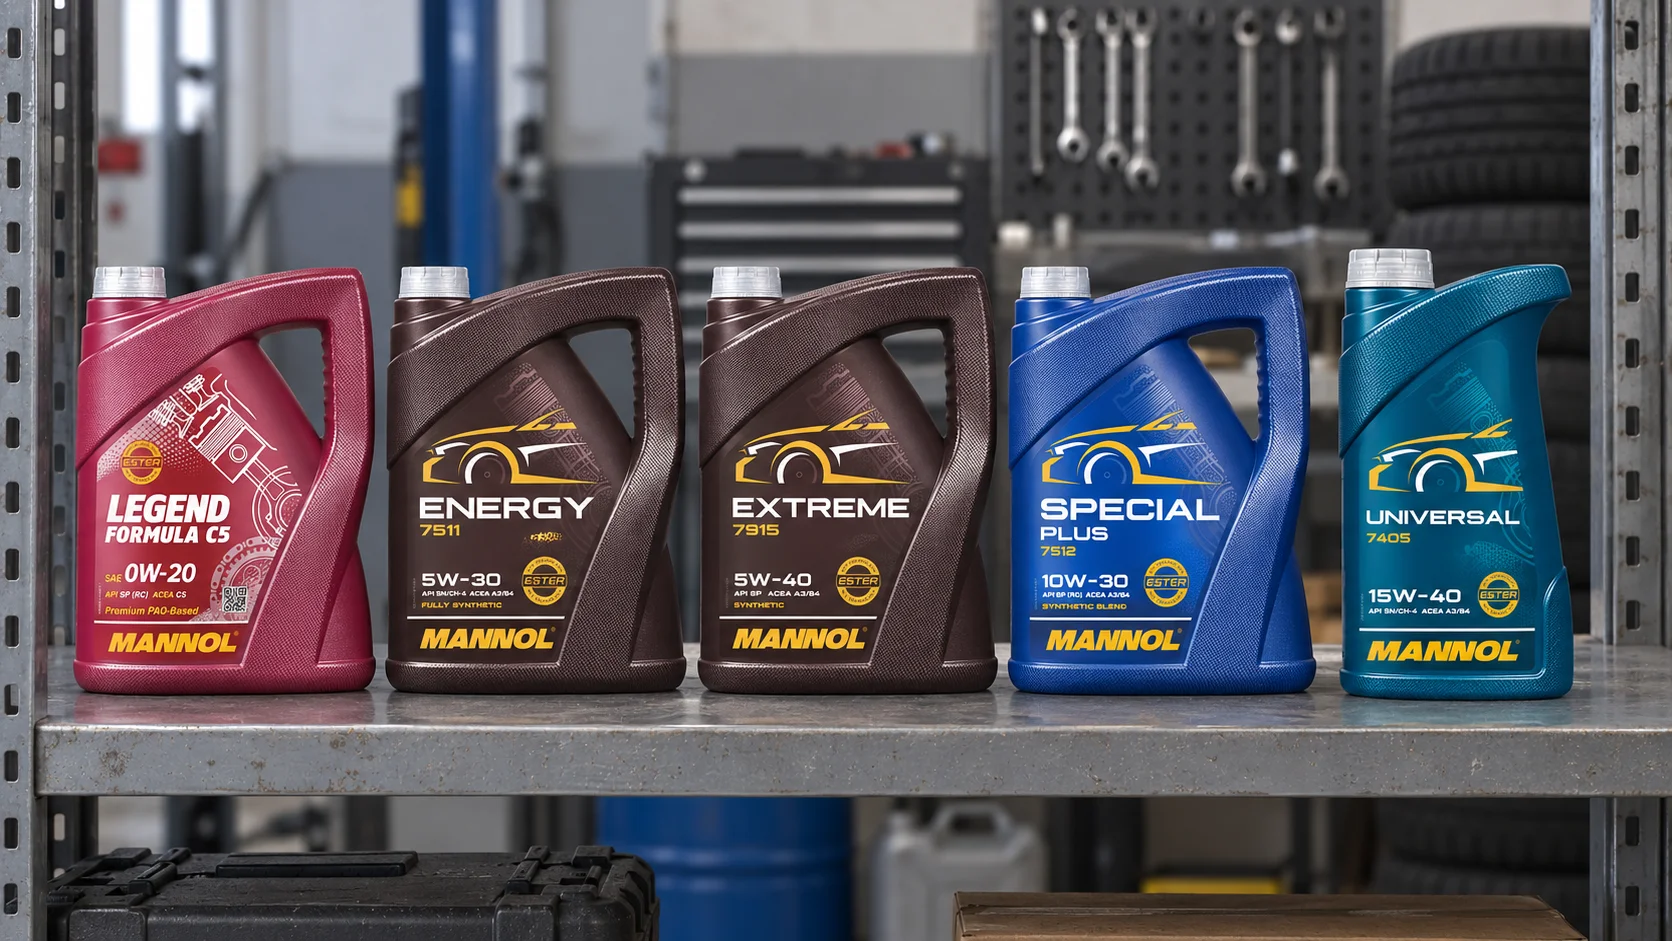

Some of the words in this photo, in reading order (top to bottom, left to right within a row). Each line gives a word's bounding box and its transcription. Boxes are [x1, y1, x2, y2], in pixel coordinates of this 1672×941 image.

[122, 458, 161, 467] ESTER
[106, 494, 231, 523] LEGEND
[419, 497, 594, 520] ENERGY
[732, 498, 910, 518] EXTREME
[1040, 498, 1220, 521] SPECIAL
[1366, 510, 1520, 525] UNIVERSAL
[104, 526, 199, 544] FORMULA
[206, 526, 231, 544] C5
[420, 524, 460, 536] 7511
[732, 524, 780, 536] 7915
[1040, 526, 1109, 541] PLUS
[1366, 532, 1411, 544] 7405
[1041, 546, 1076, 556] 7512
[105, 574, 122, 583] SAE
[124, 563, 197, 583] 0W-20
[422, 572, 501, 587] 5W-30
[734, 572, 812, 587] 5W-40
[524, 576, 566, 586] ESTER
[838, 576, 879, 586] ESTER
[1042, 574, 1129, 588] 10W-30
[1146, 578, 1187, 587] ESTER
[132, 591, 149, 600] (RC)
[1368, 588, 1462, 603] 15W-40
[1480, 590, 1517, 600] ESTER
[105, 606, 145, 616] Premium
[148, 606, 199, 616] PAO-Based
